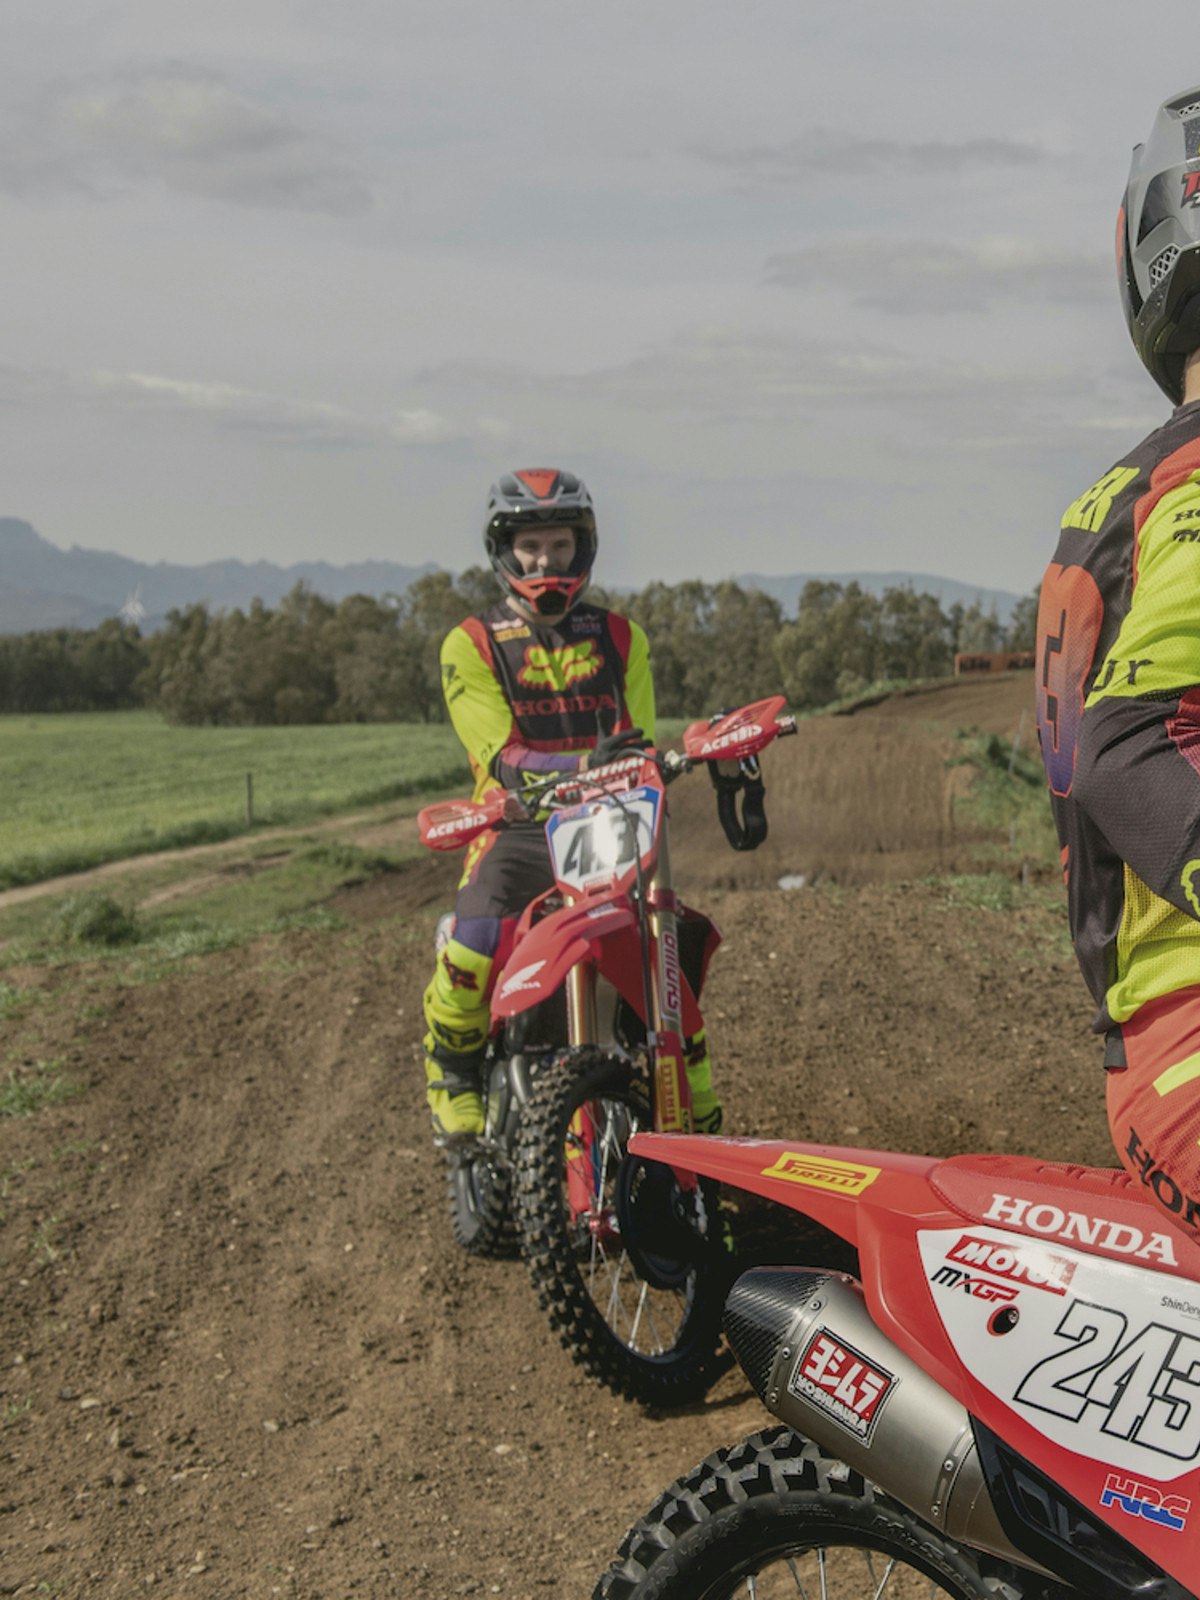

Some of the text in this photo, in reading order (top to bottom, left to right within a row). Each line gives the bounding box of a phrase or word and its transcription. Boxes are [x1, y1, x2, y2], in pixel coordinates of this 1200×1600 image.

[512, 694, 618, 716] HONDA
[780, 1158, 867, 1189] PIRELLI
[982, 1193, 1180, 1267] HONDA
[930, 1265, 1020, 1303] MXGP
[1100, 1472, 1192, 1533] HRC
